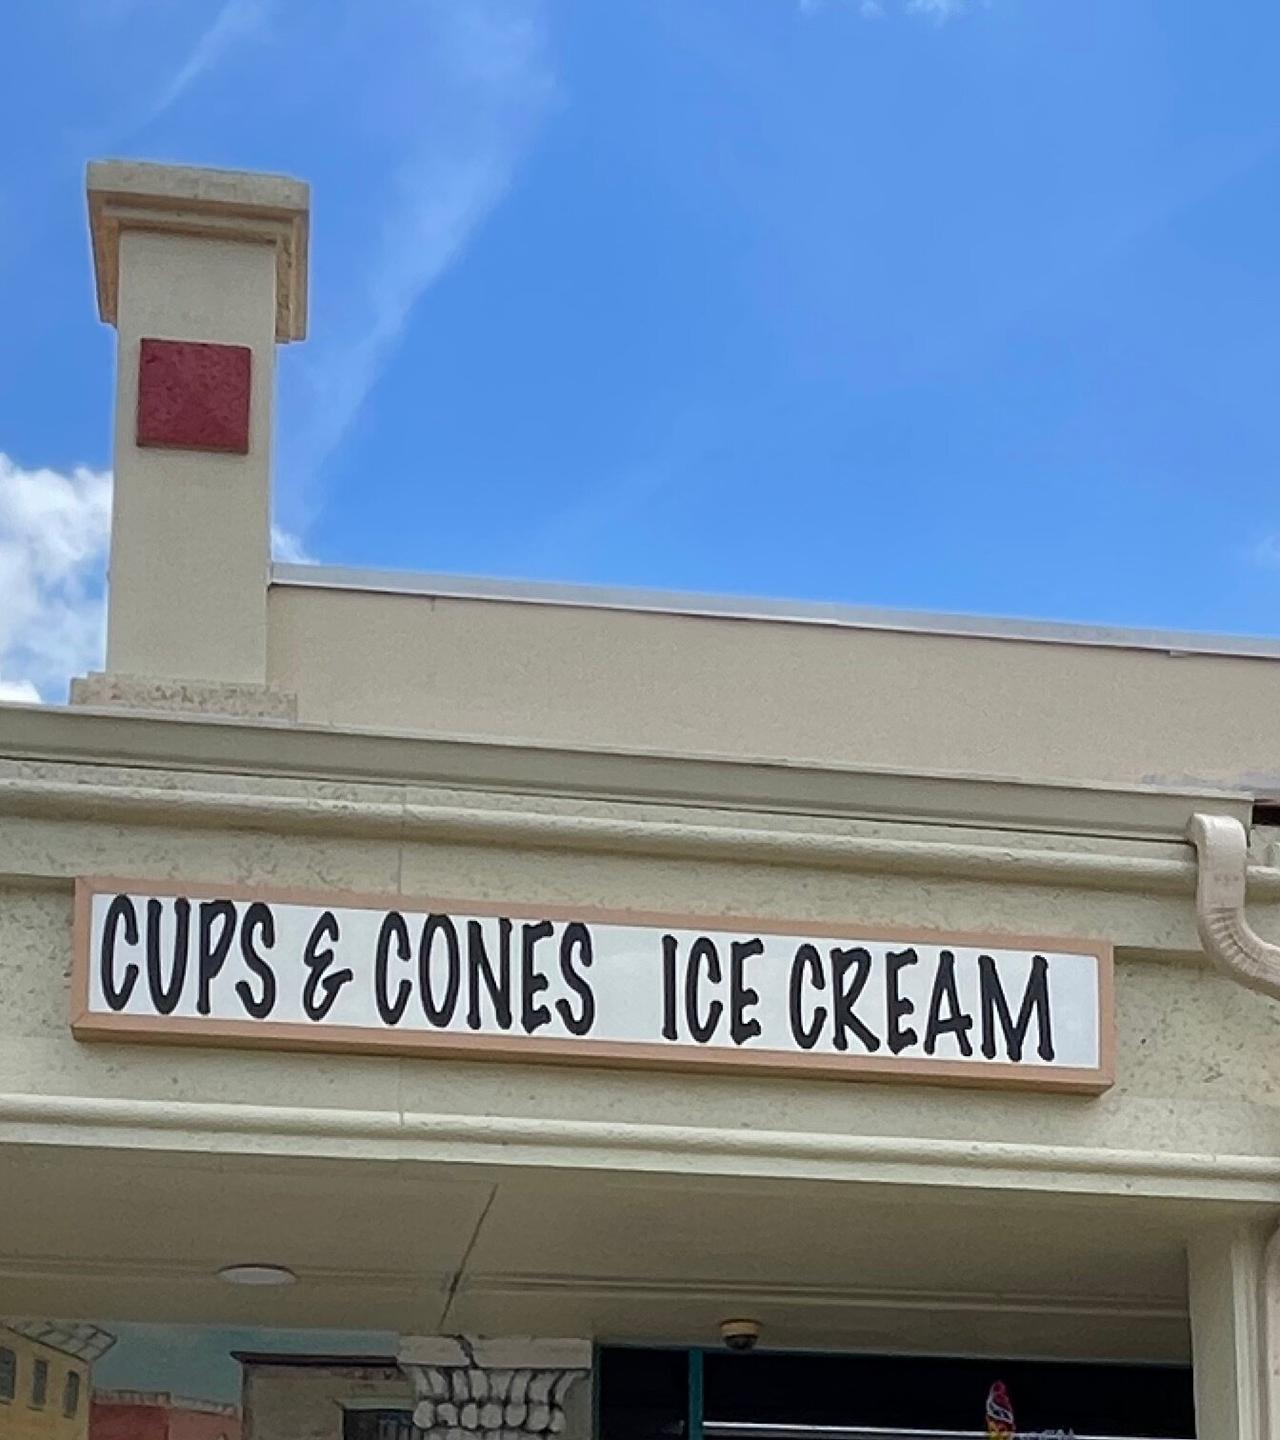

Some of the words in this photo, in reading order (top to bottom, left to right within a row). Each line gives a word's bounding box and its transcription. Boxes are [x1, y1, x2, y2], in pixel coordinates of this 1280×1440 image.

[101, 894, 276, 1018] CUPS
[304, 911, 354, 1021] &
[375, 911, 595, 1035] CONES
[662, 934, 764, 1045] ICE
[789, 943, 1055, 1062] CREAM
